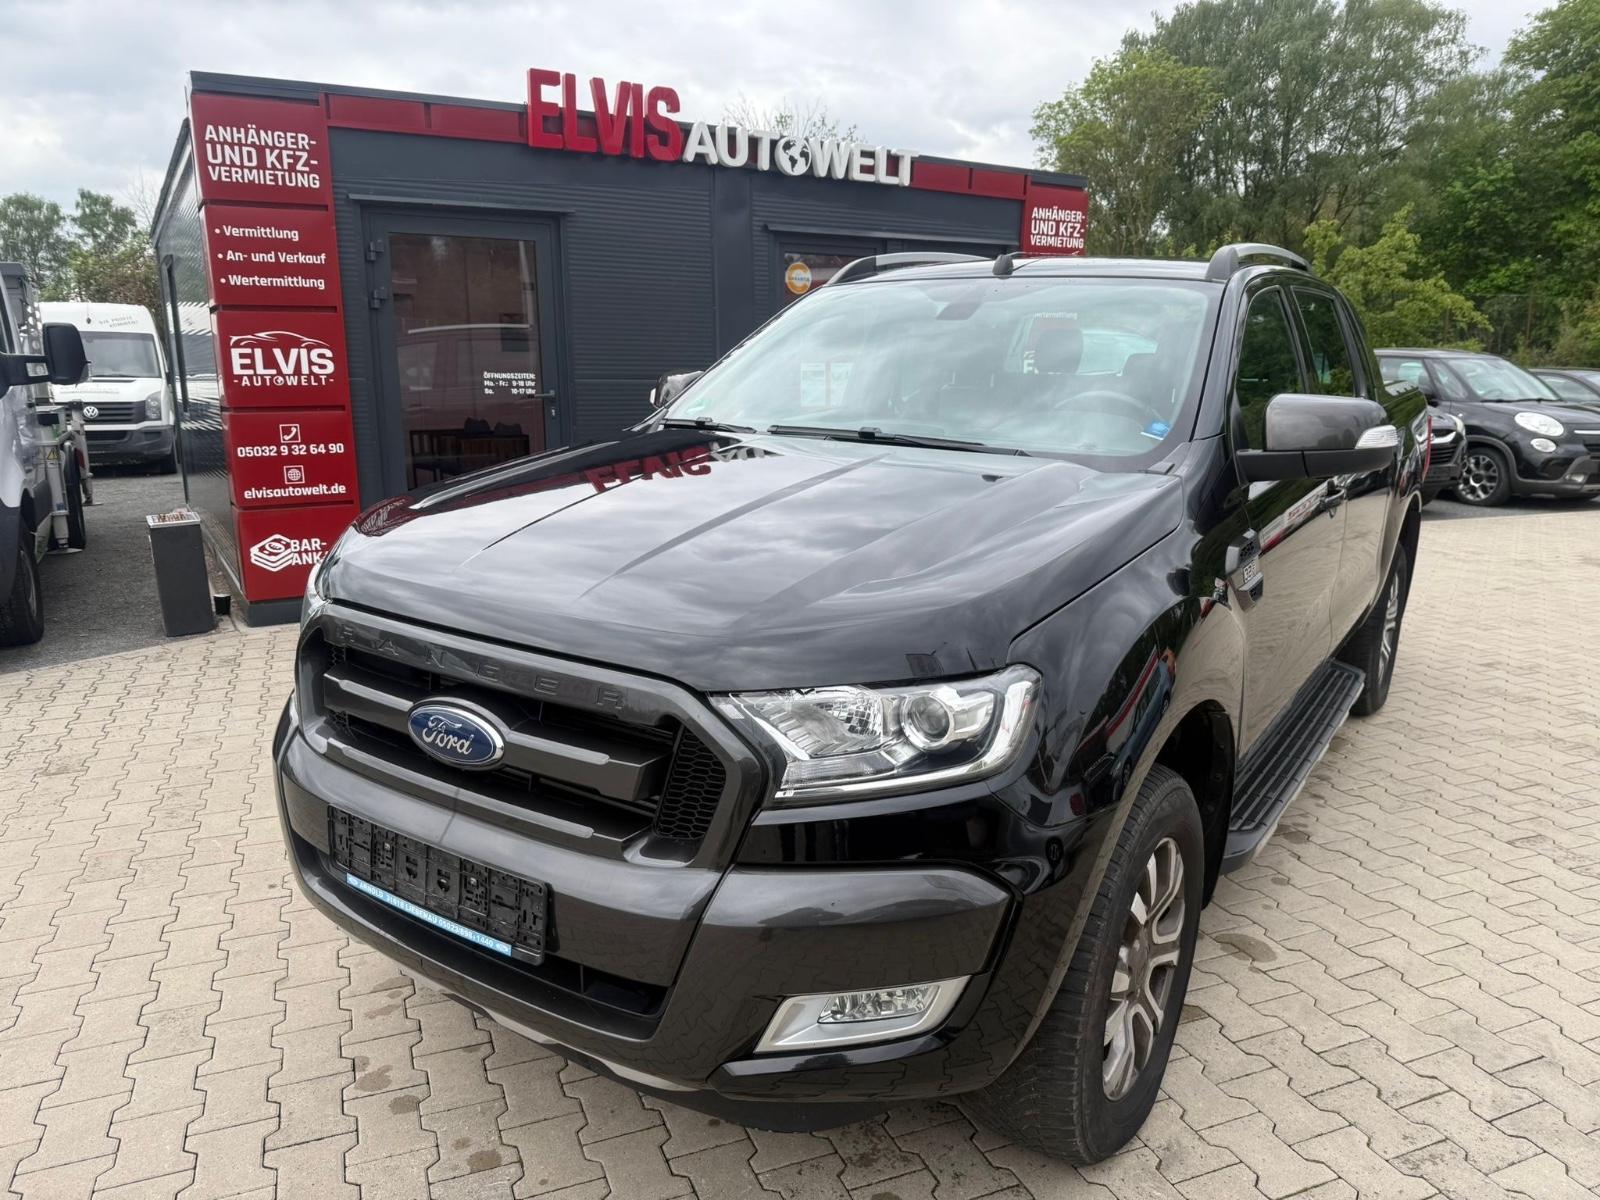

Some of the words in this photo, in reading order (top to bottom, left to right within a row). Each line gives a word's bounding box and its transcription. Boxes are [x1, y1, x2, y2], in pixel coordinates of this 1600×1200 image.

[526, 67, 683, 162] ELVIS
[682, 120, 920, 187] AUTOWELT
[204, 124, 317, 150] ANHÄNGER-
[206, 143, 257, 167] UND
[265, 148, 318, 172] KFZ-
[208, 166, 320, 189] VERMIETUNG
[1031, 206, 1086, 223] ANHÄNGER-
[222, 225, 299, 242] Vermittlung
[1031, 220, 1056, 235] UND
[1059, 222, 1085, 238] KFZ-
[1030, 234, 1085, 249] VERMIETUNG
[226, 250, 248, 262] An-
[251, 251, 276, 263] und
[278, 252, 327, 265] Verkauf
[228, 274, 325, 290] Wertermittlung
[230, 347, 336, 375] ELVIS
[237, 446, 278, 458] 05032
[280, 445, 289, 456] 9
[291, 444, 307, 455] 32
[310, 443, 326, 455] 64
[328, 442, 345, 454] 90
[243, 483, 347, 499] elvisautowelt.de
[290, 538, 327, 552] BAR-
[421, 714, 476, 756] Ford
